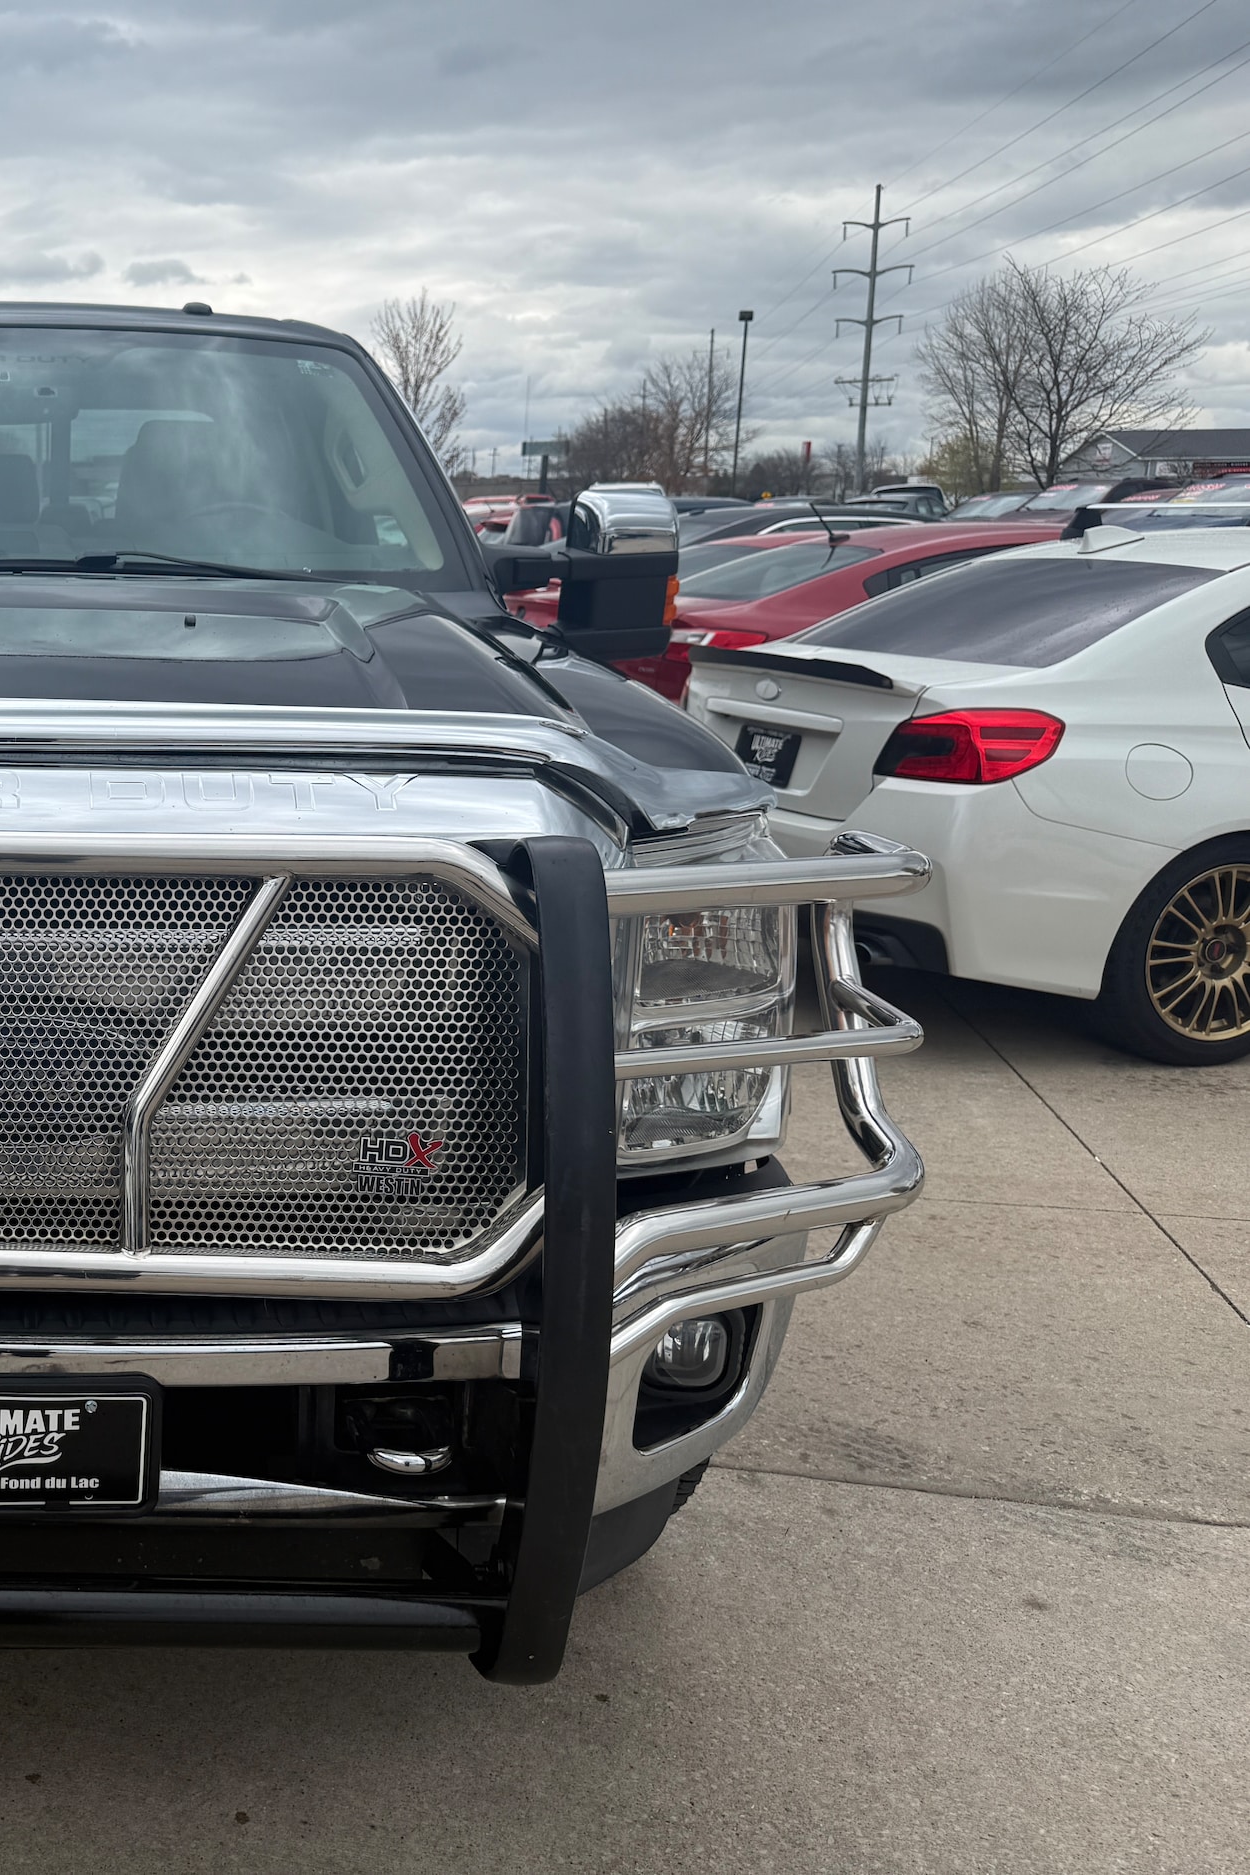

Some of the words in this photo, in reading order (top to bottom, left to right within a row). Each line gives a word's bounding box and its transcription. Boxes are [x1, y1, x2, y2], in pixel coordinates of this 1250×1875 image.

[89, 771, 419, 811] DUTY
[360, 1132, 444, 1170] HDX
[358, 1165, 392, 1173] HEAVY
[395, 1167, 422, 1175] DUTY
[0, 1477, 41, 1490] Fond
[44, 1477, 67, 1490] du
[70, 1476, 100, 1489] Lac
